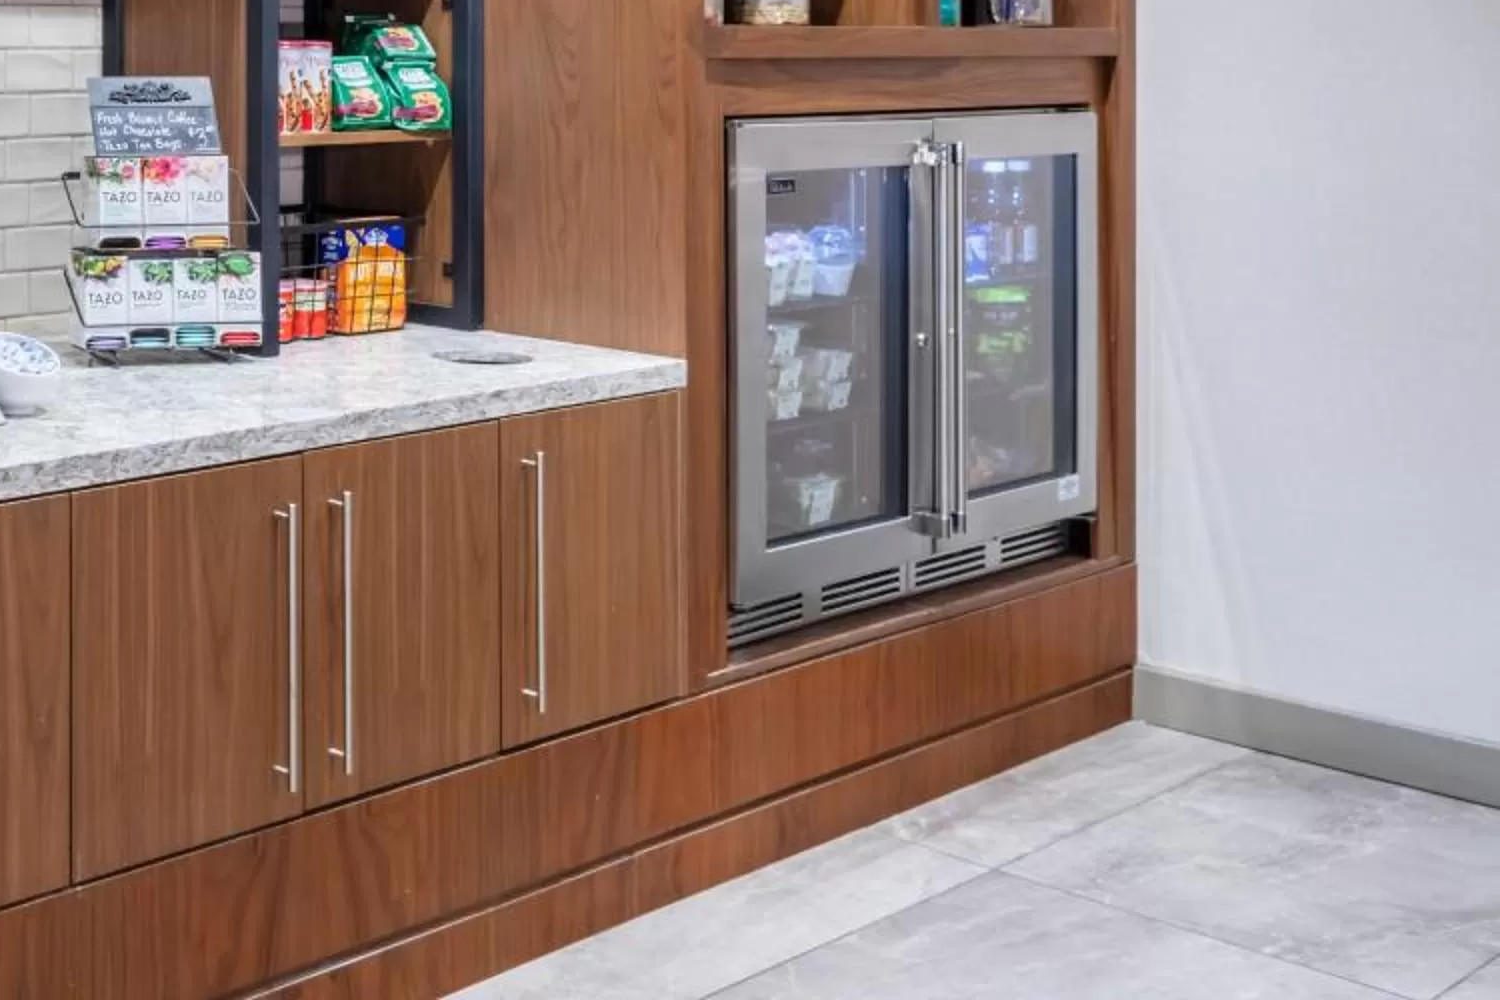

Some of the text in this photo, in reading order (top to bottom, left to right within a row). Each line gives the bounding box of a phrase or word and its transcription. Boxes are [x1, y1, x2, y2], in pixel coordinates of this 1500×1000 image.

[101, 191, 137, 203] TAZO
[146, 191, 181, 203] TAZO
[190, 191, 224, 203] TAZO
[88, 292, 123, 305] TAZO
[132, 289, 163, 301] TAZO
[177, 289, 207, 300] TAZO
[222, 288, 257, 301] TAZO
